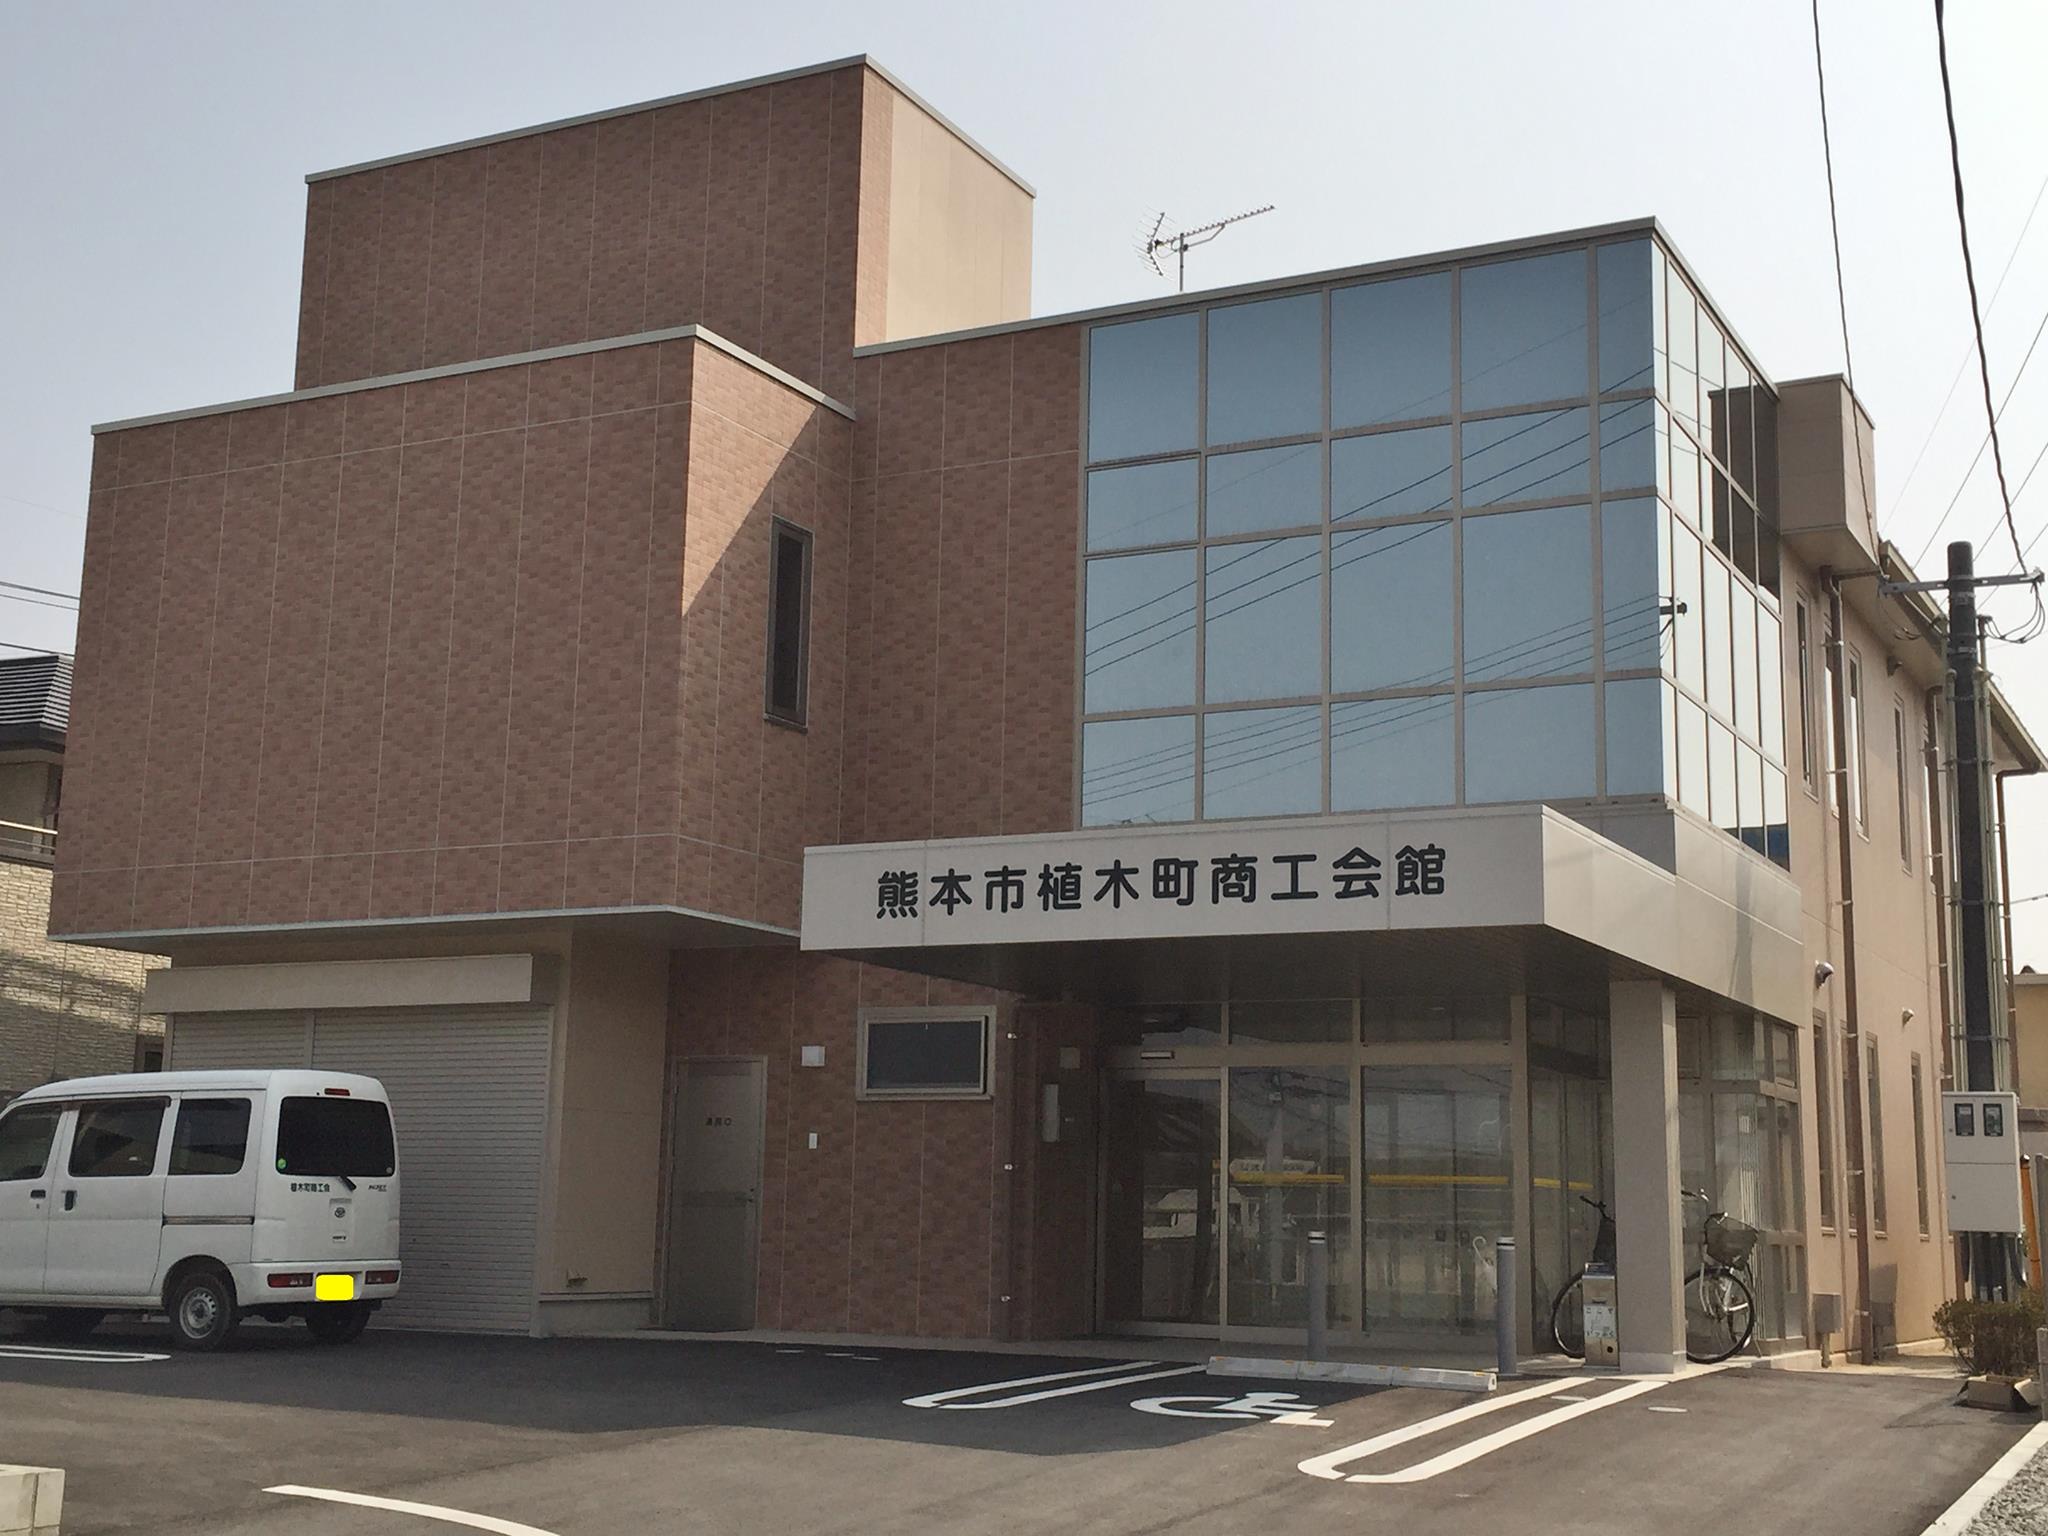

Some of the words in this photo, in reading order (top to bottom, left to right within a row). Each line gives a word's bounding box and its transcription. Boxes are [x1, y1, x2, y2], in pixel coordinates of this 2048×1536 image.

[876, 844, 1446, 919] 熊本市植木町商工会館
